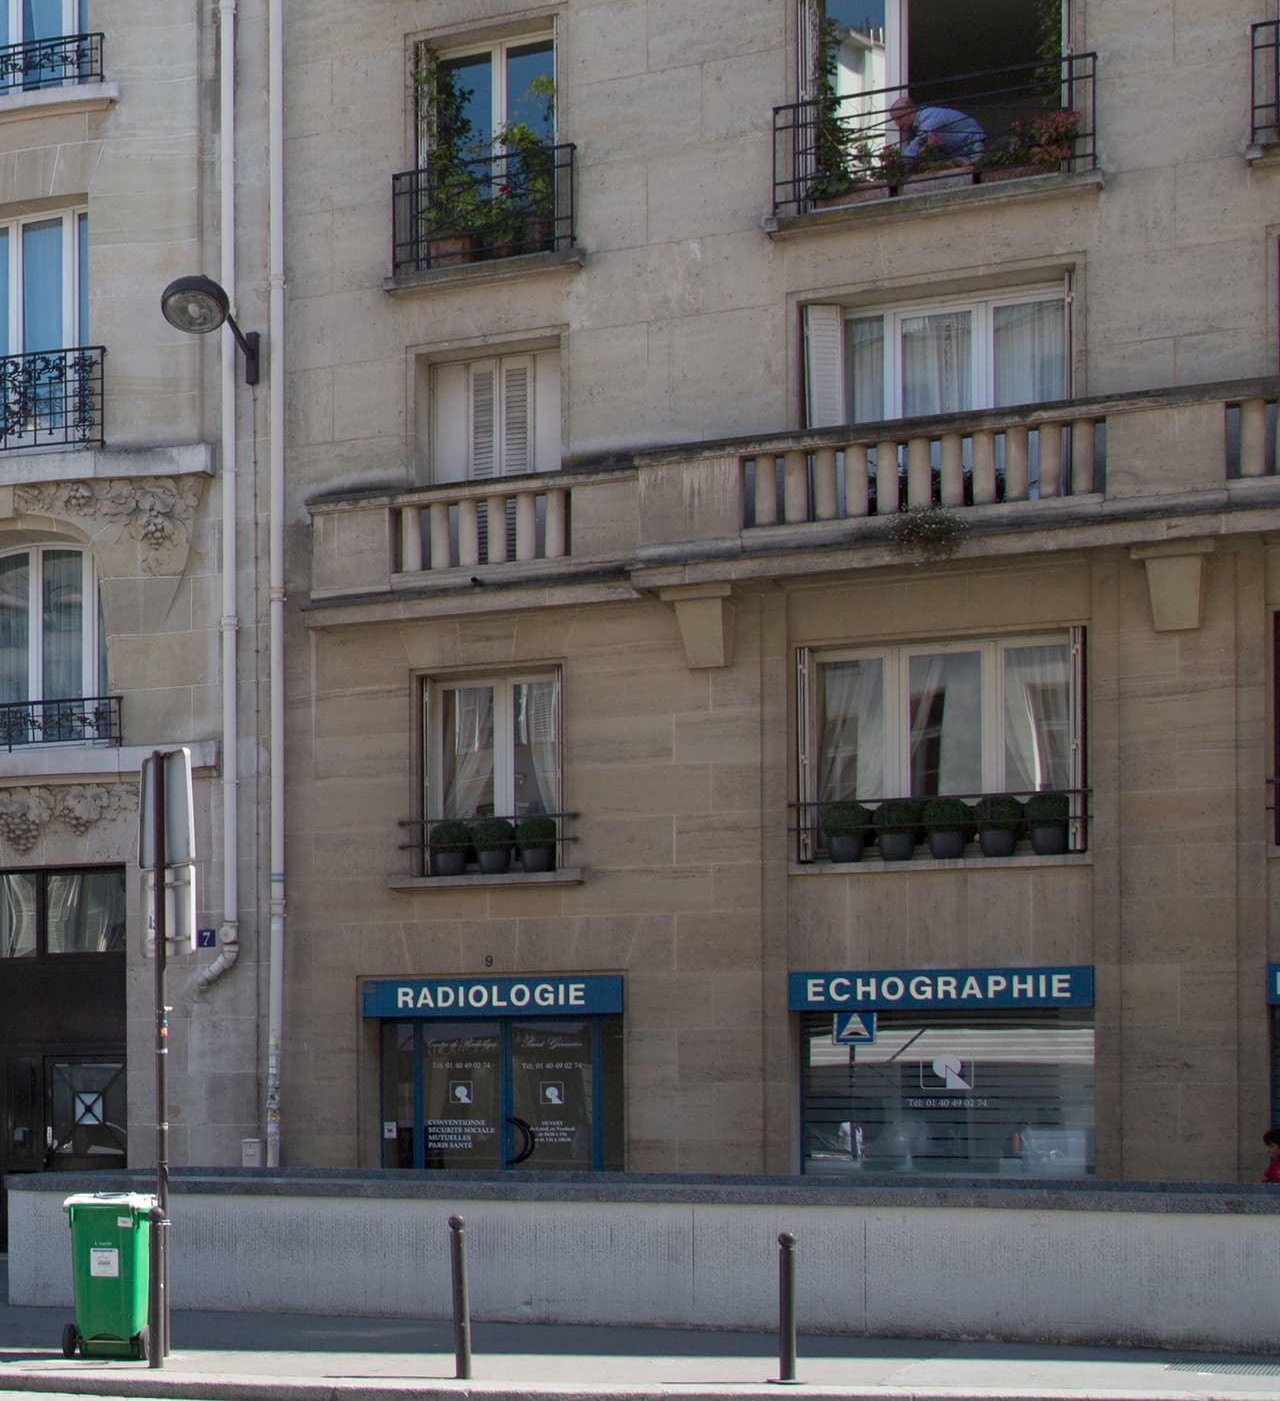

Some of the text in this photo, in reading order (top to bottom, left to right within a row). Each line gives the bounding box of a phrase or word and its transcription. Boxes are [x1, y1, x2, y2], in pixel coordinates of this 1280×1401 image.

[202, 931, 211, 946] 7
[484, 955, 494, 968] 9
[806, 974, 1072, 1002] ECHOGRAPHIE
[397, 983, 586, 1008] RADIOLOGIE
[926, 1098, 936, 1107] 01
[938, 1098, 949, 1107] 40
[951, 1098, 962, 1107] 49
[977, 1098, 987, 1107] 74
[428, 1141, 448, 1149] PARIS
